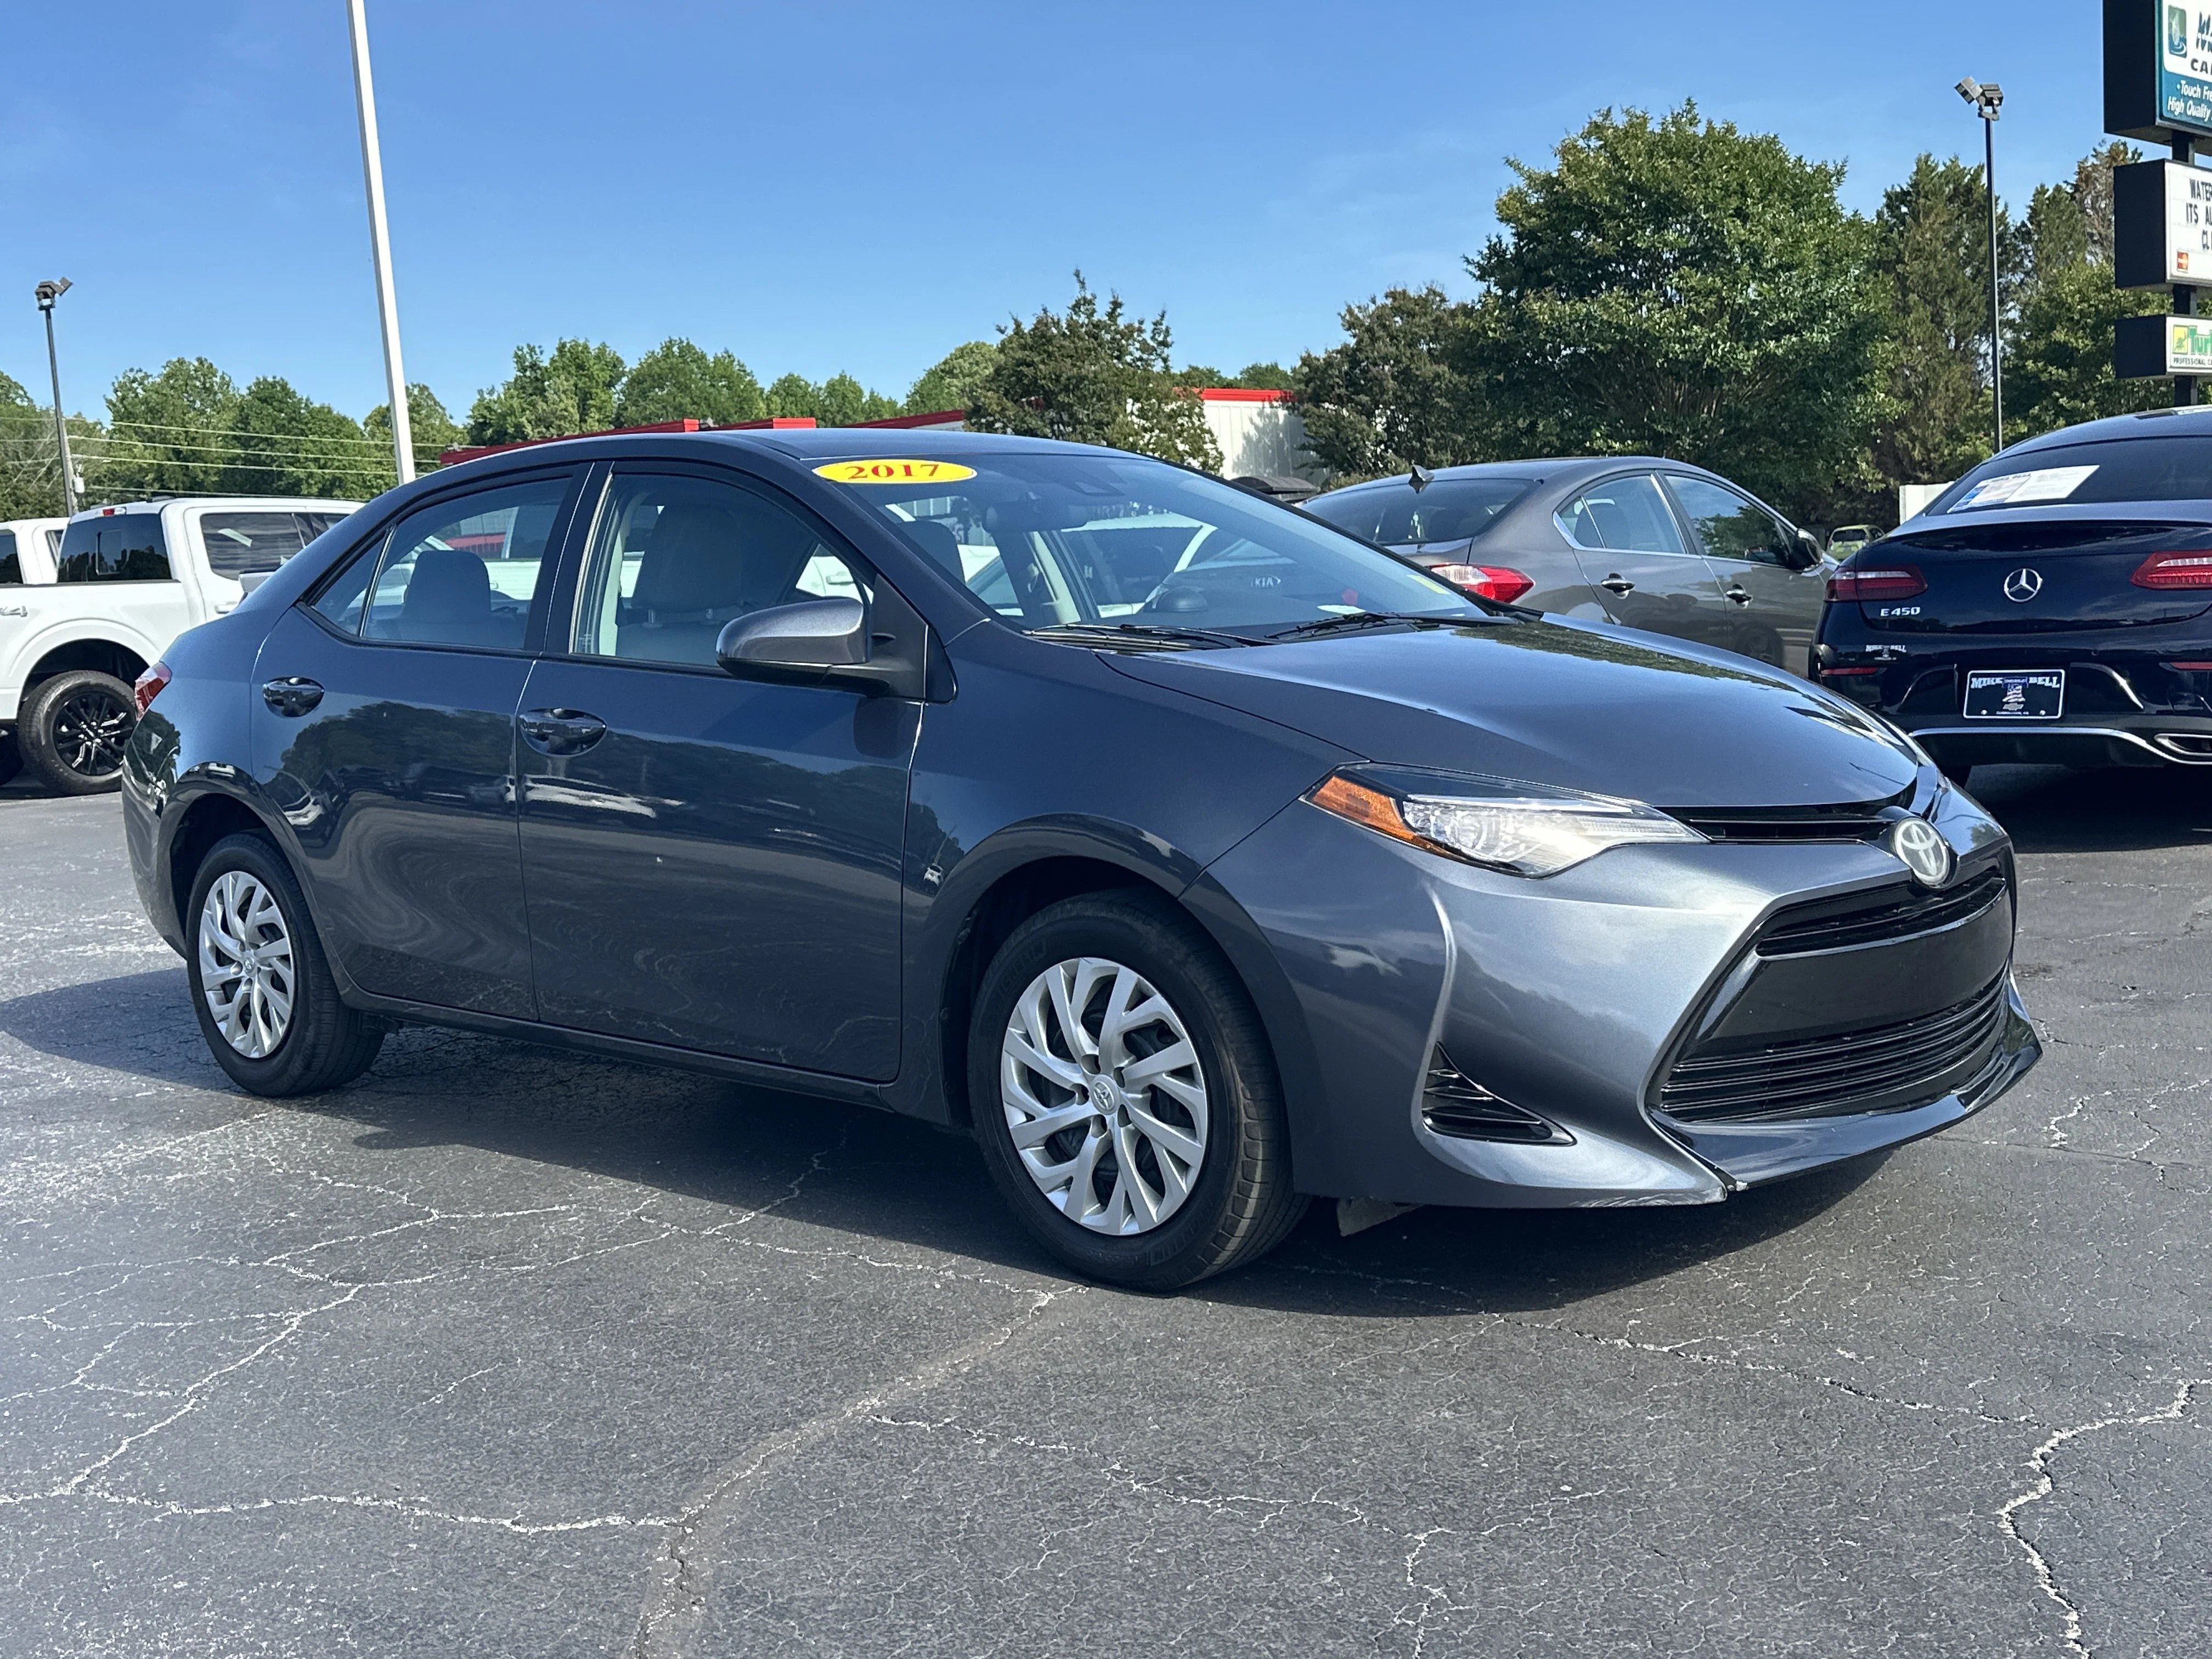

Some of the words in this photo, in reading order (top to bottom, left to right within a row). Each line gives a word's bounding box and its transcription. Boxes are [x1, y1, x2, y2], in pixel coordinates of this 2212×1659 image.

[2191, 58, 2212, 75] CA
[2180, 80, 2201, 99] Touch
[2168, 95, 2185, 116] High
[2186, 100, 2211, 122] Quality
[2186, 202, 2198, 224] ITS
[845, 464, 939, 479] 2017
[1255, 577, 1274, 588] KIA
[1880, 608, 1890, 617] E
[1891, 607, 1921, 616] 450
[1971, 677, 2002, 689] MIKE
[2029, 676, 2060, 688] BELL
